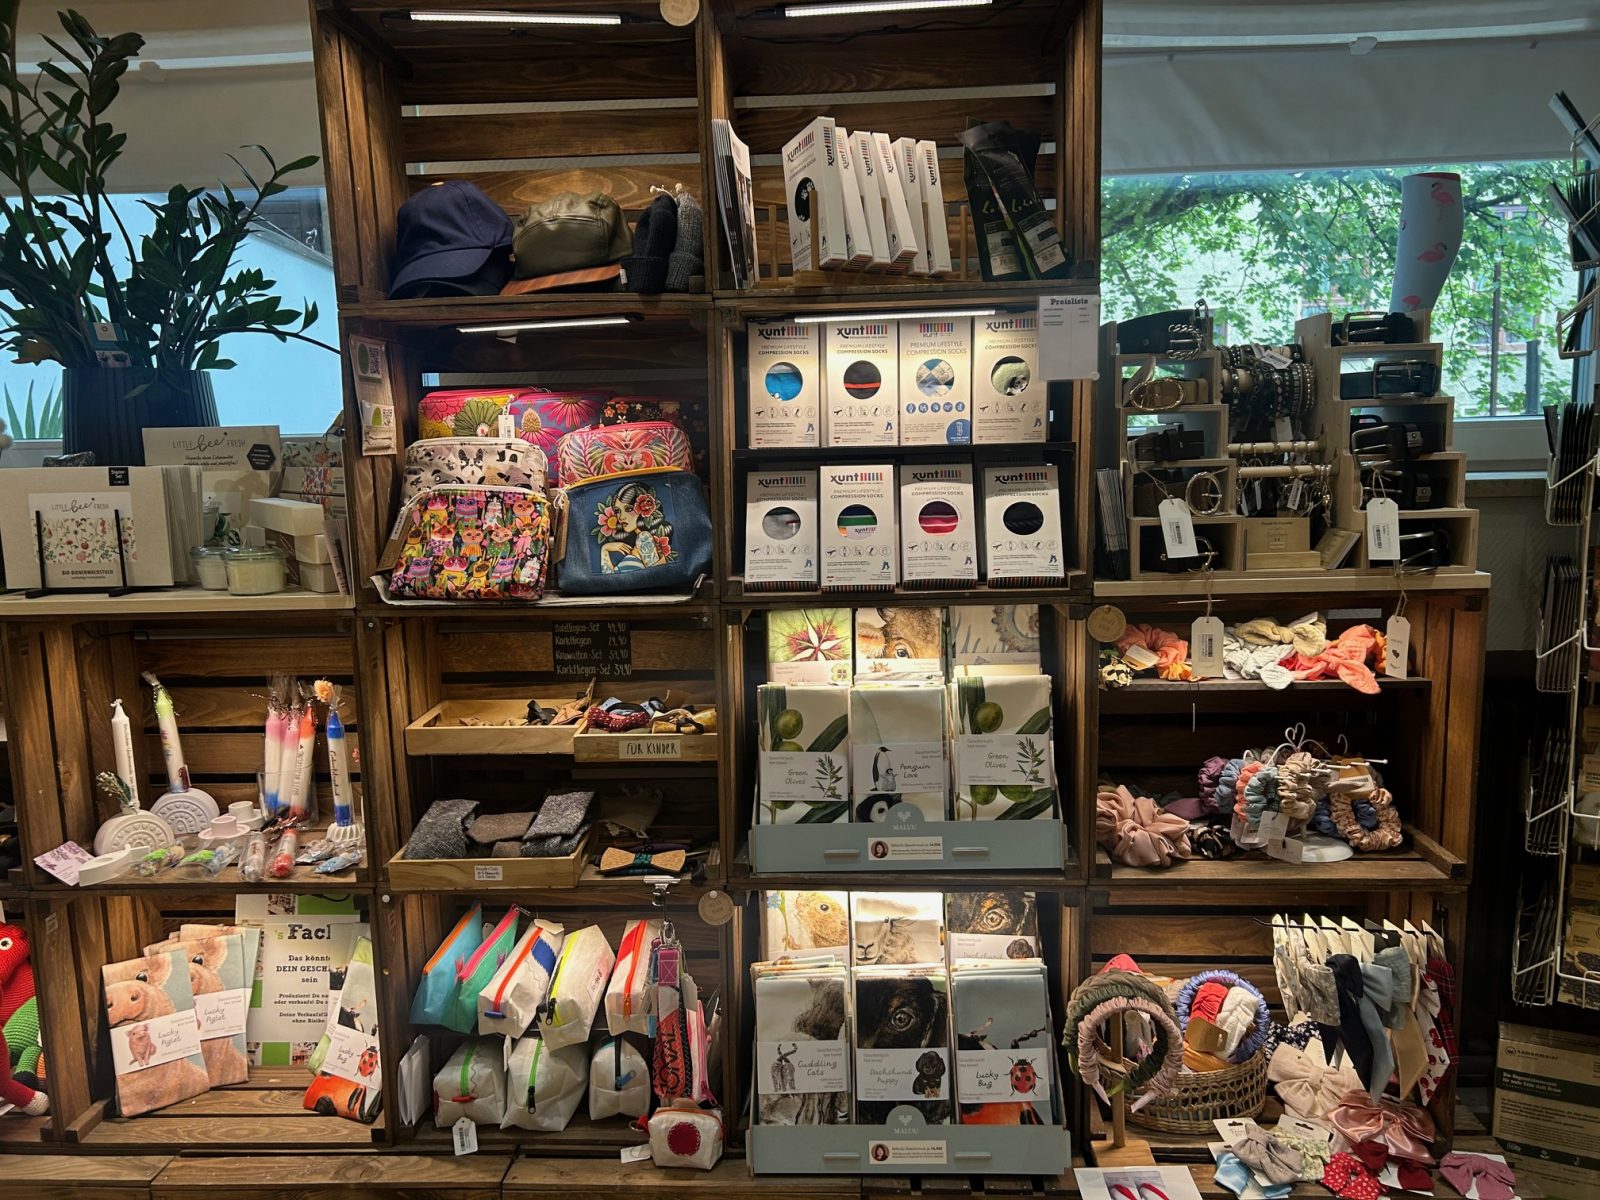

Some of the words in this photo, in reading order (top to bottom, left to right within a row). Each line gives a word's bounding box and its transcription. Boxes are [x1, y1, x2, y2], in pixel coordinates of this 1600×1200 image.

[986, 319, 1014, 333] xunt
[758, 326, 786, 340] xunt
[837, 325, 865, 339] xunt
[173, 440, 193, 449] LITTLE
[830, 473, 859, 485] xunt
[912, 470, 940, 482] xunt
[995, 472, 1024, 484] xunt
[758, 477, 785, 488] xunt
[626, 742, 643, 755] FÜR
[646, 742, 678, 755] KINDER
[900, 763, 931, 772] Penguin
[985, 761, 1007, 769] Olives
[205, 1005, 225, 1016] Lucky
[206, 1014, 226, 1024] Piglet
[158, 1028, 179, 1039] Lucky
[162, 1037, 182, 1048] Piglet
[798, 1061, 837, 1069] Cuddling
[976, 1070, 999, 1080] Lucky
[877, 1077, 899, 1086] Puppy
[978, 1080, 993, 1089] Bug
